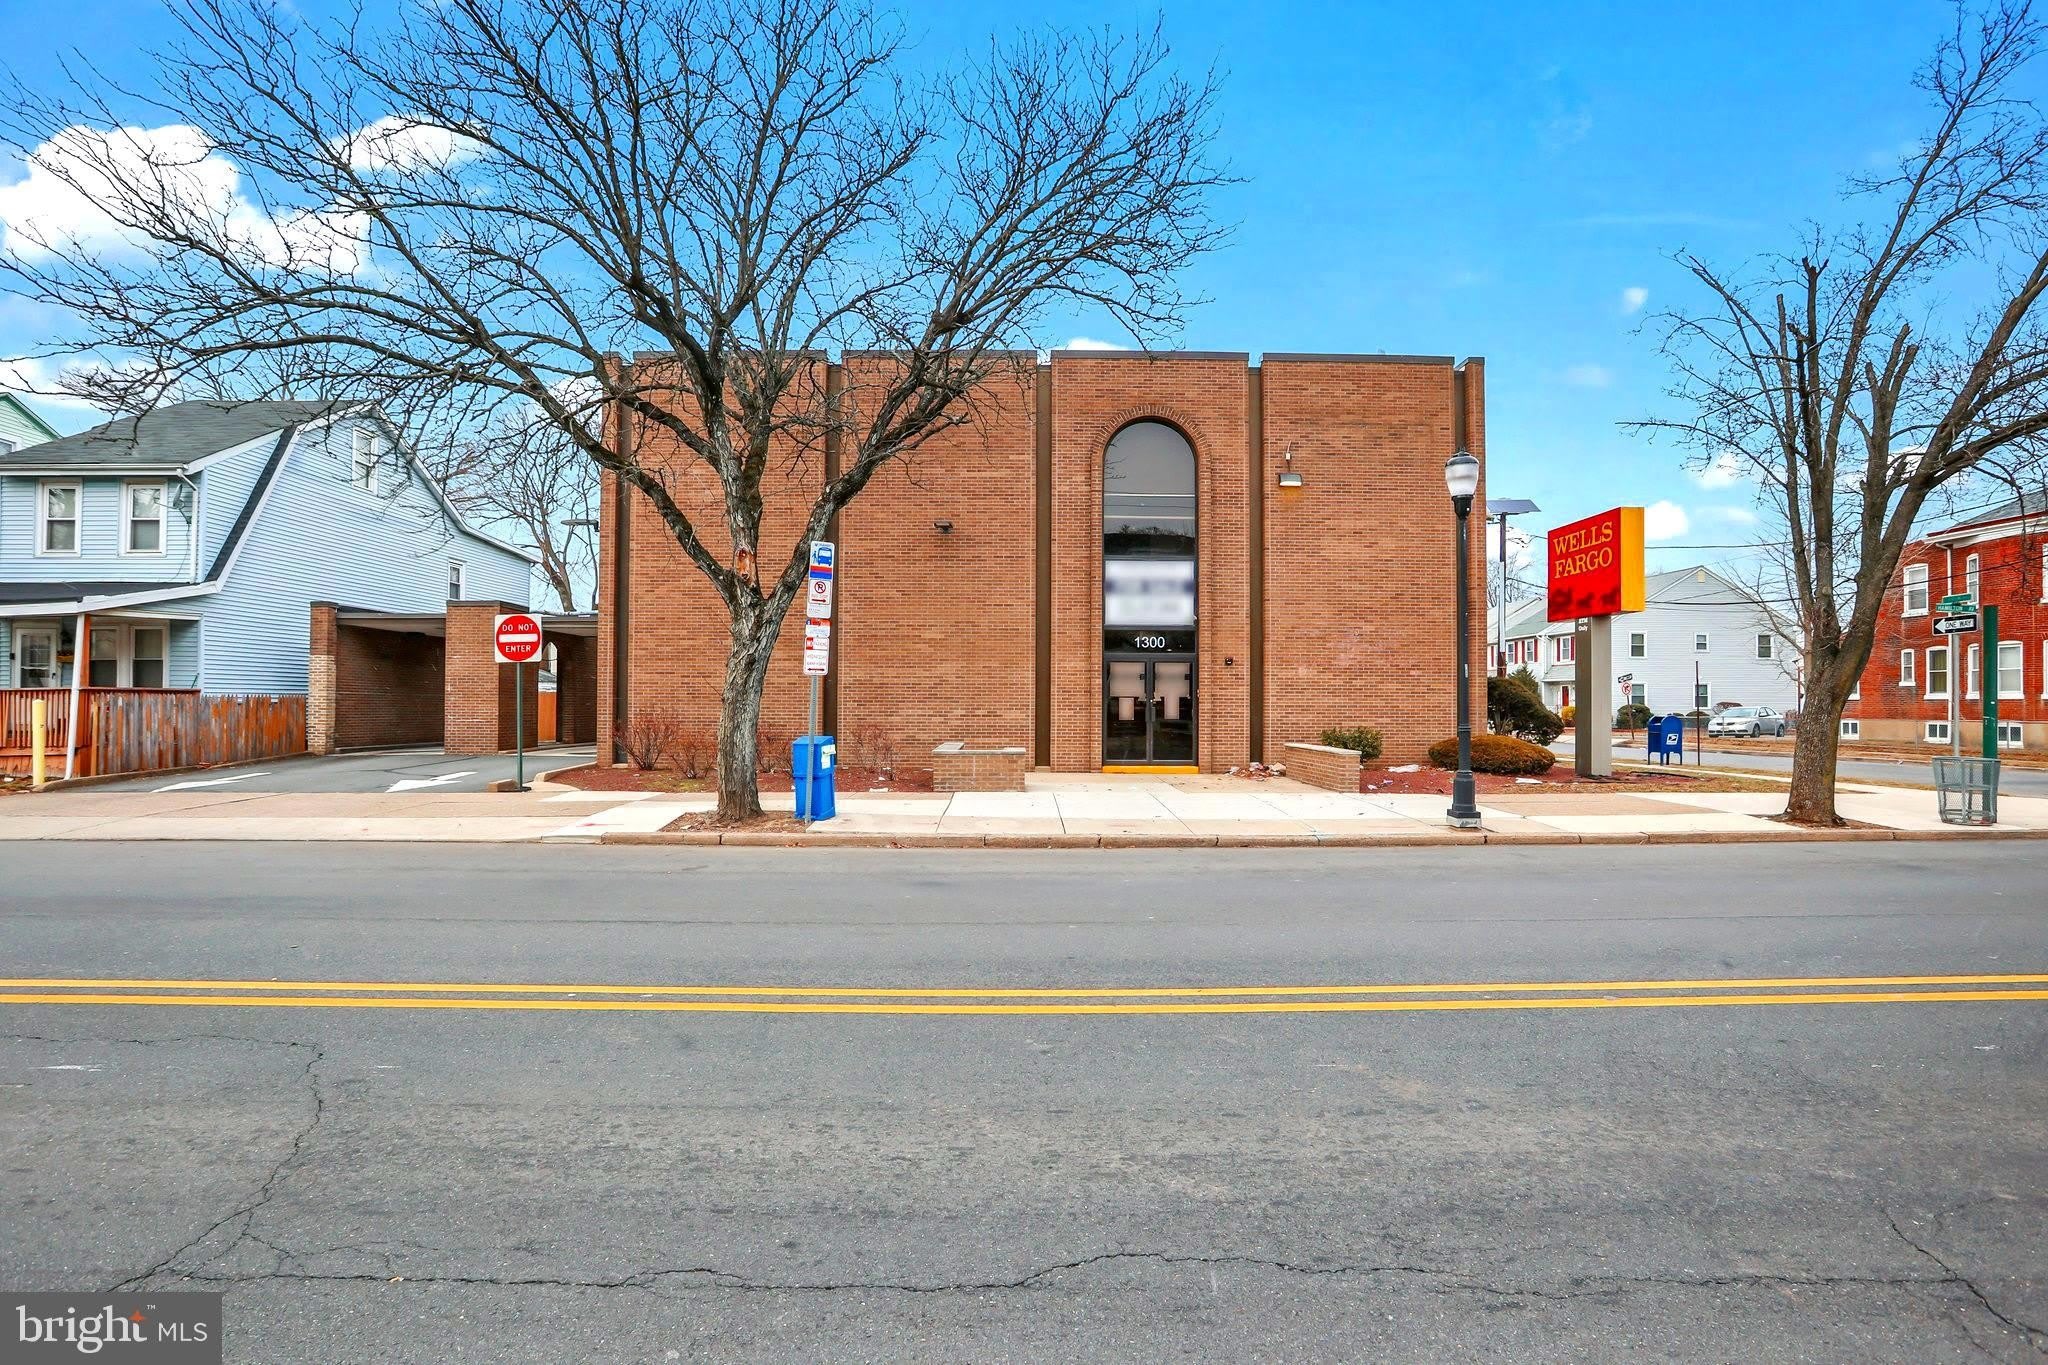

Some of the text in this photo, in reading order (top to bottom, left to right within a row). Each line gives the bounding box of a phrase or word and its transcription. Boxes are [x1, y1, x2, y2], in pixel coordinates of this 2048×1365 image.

[1553, 521, 1613, 556] WELLS
[1554, 547, 1613, 579] FARGO
[502, 623, 534, 632] DO NOT
[1945, 620, 1972, 629] ONE WAY
[1134, 636, 1166, 649] 1300
[505, 644, 532, 653] ENTER
